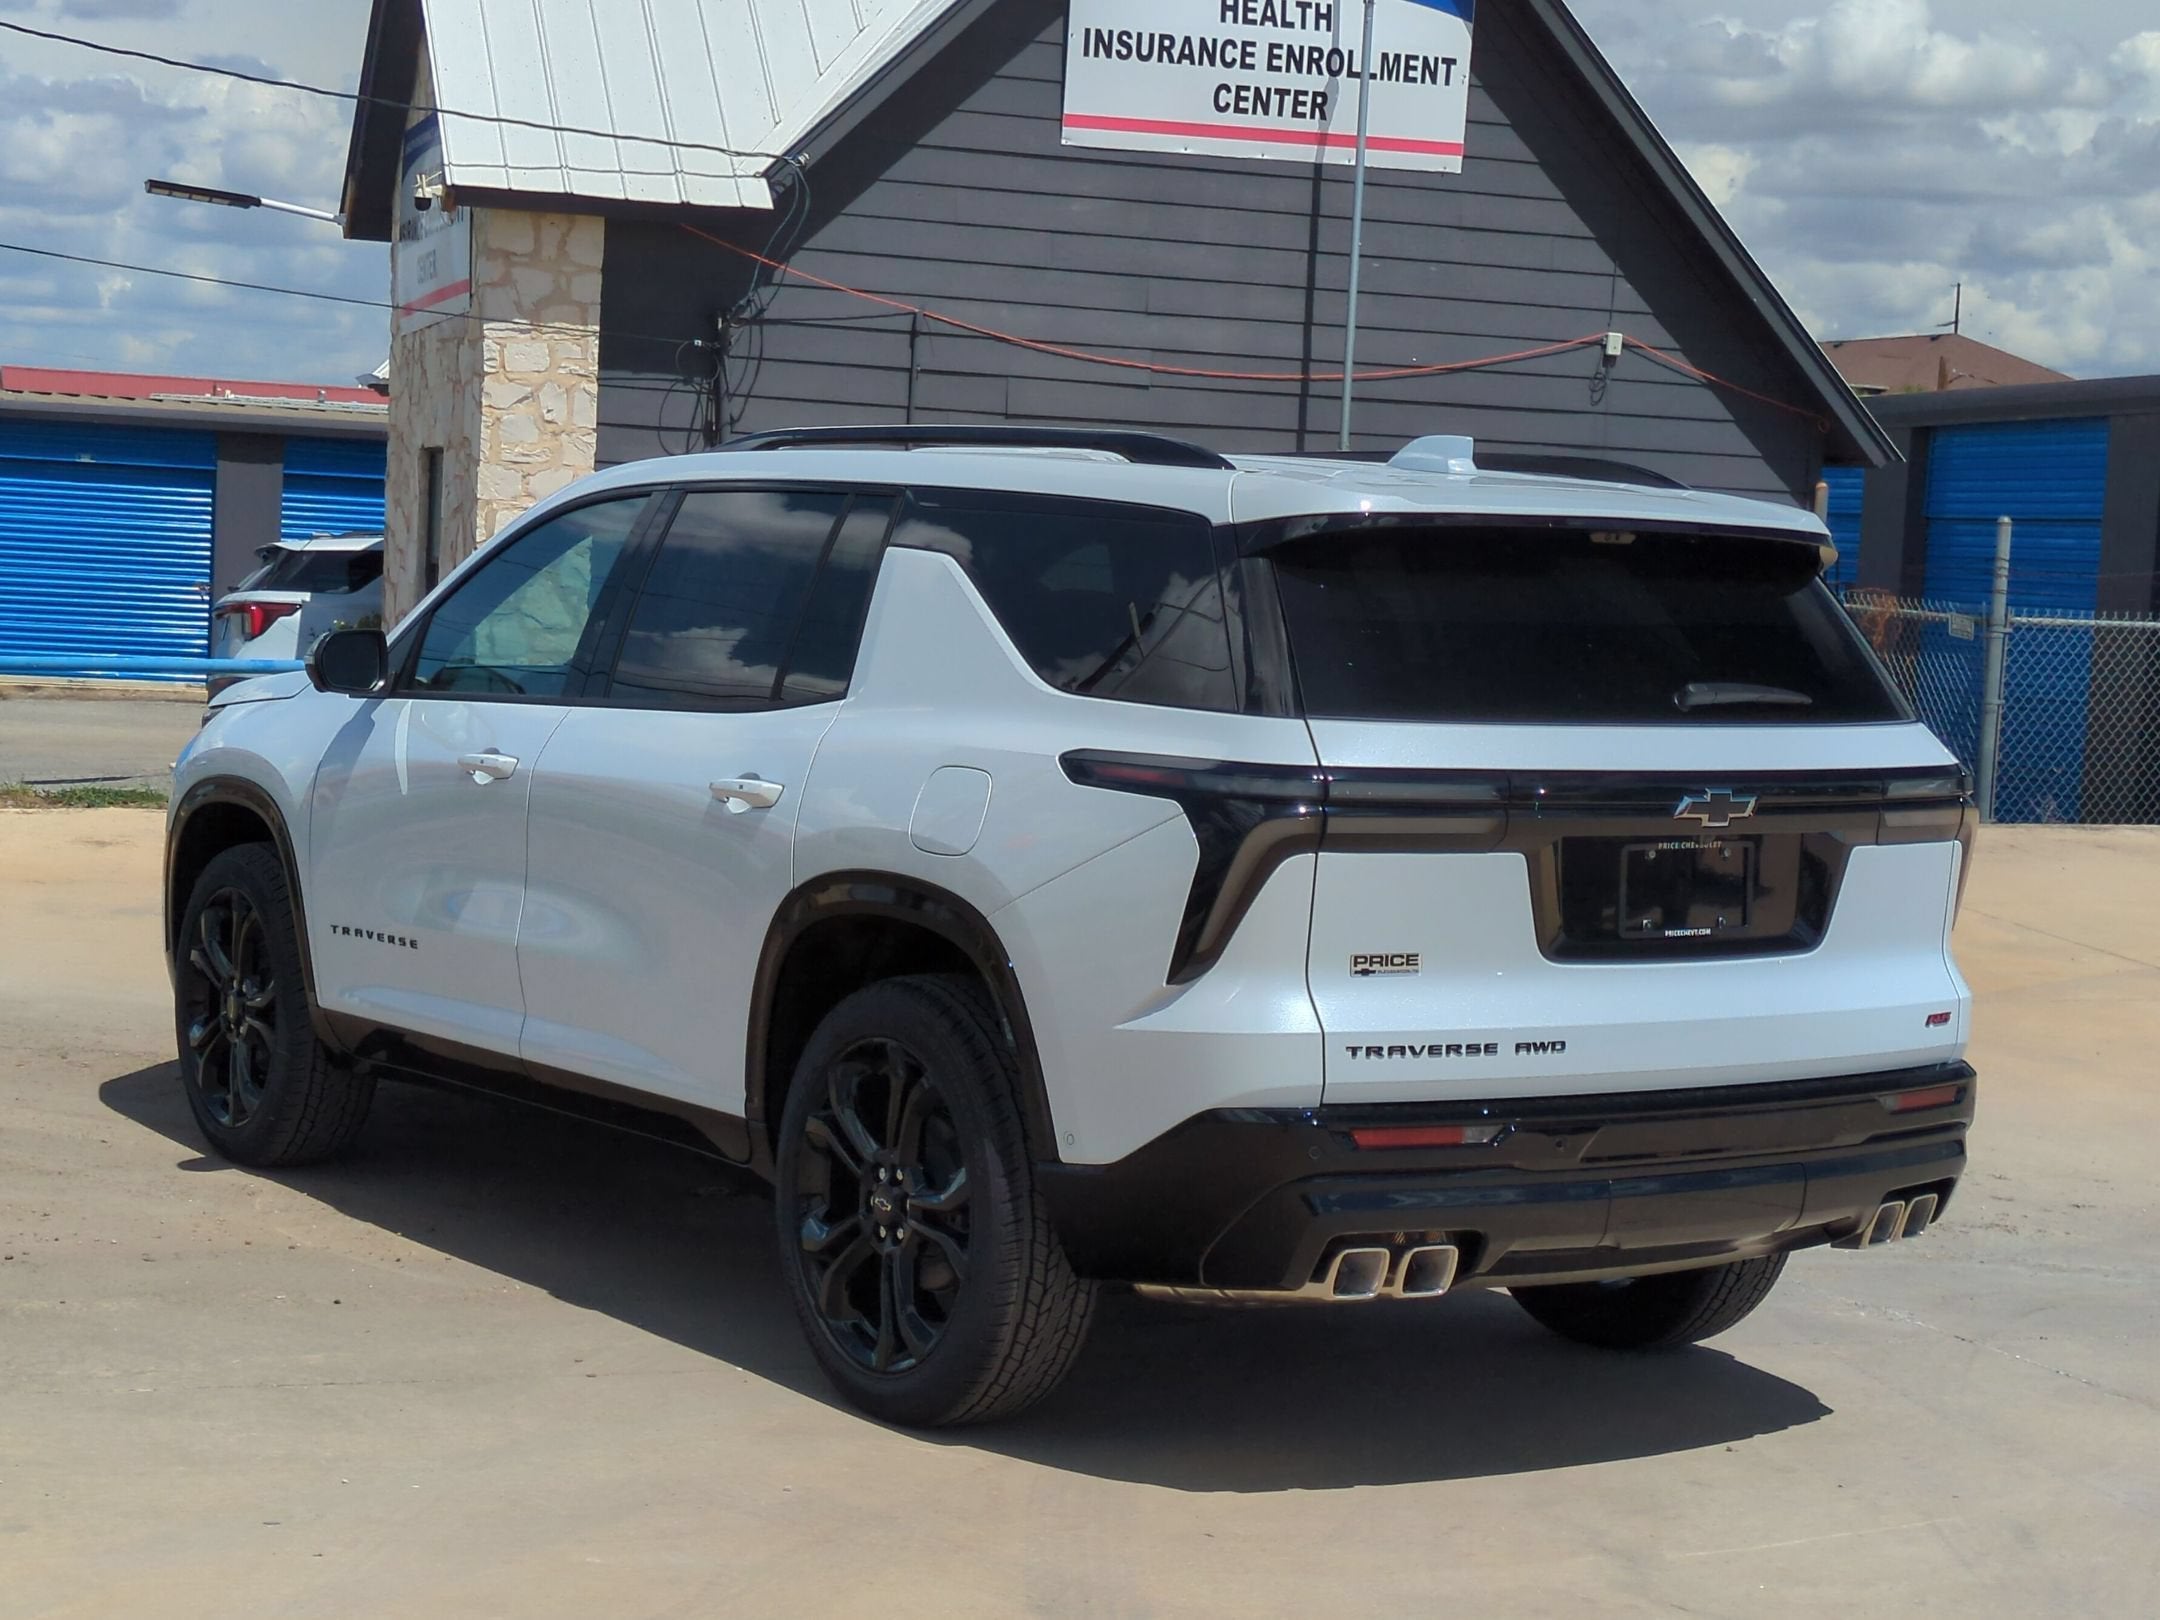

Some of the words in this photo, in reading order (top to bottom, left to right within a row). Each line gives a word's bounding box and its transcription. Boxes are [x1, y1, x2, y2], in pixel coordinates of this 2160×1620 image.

[1220, 0, 1333, 32] HEALTH
[1083, 27, 1257, 70] INSURANCE
[1213, 83, 1328, 121] CENTER
[1658, 841, 1679, 849] PRICE
[330, 924, 418, 949] TRAVERSE
[1353, 953, 1420, 968] PRICE
[1346, 1042, 1499, 1060] TRAVERSE
[1515, 1040, 1567, 1056] AWD
